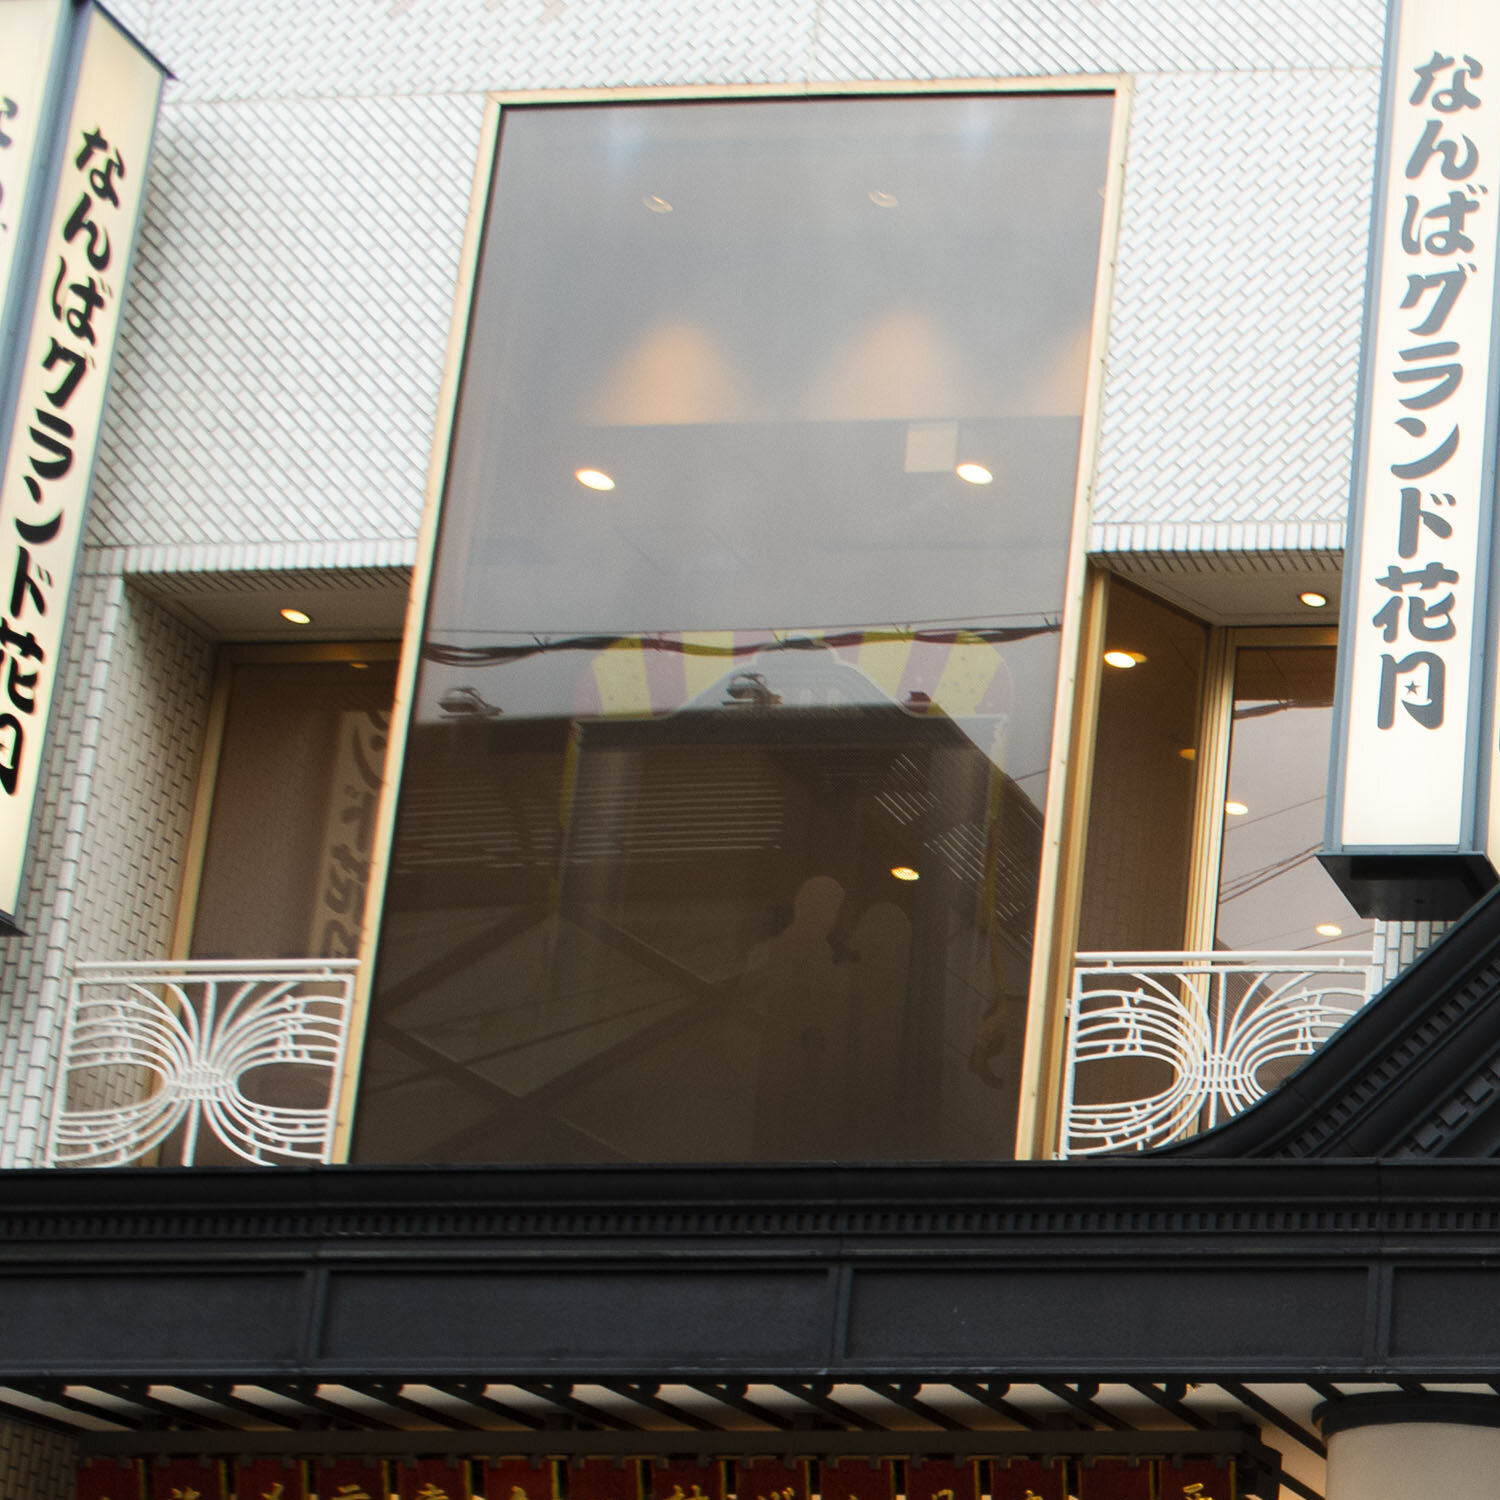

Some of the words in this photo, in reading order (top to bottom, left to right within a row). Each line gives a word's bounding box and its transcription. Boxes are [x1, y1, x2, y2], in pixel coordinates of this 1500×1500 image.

[1372, 50, 1484, 731] なんばグランド花月
